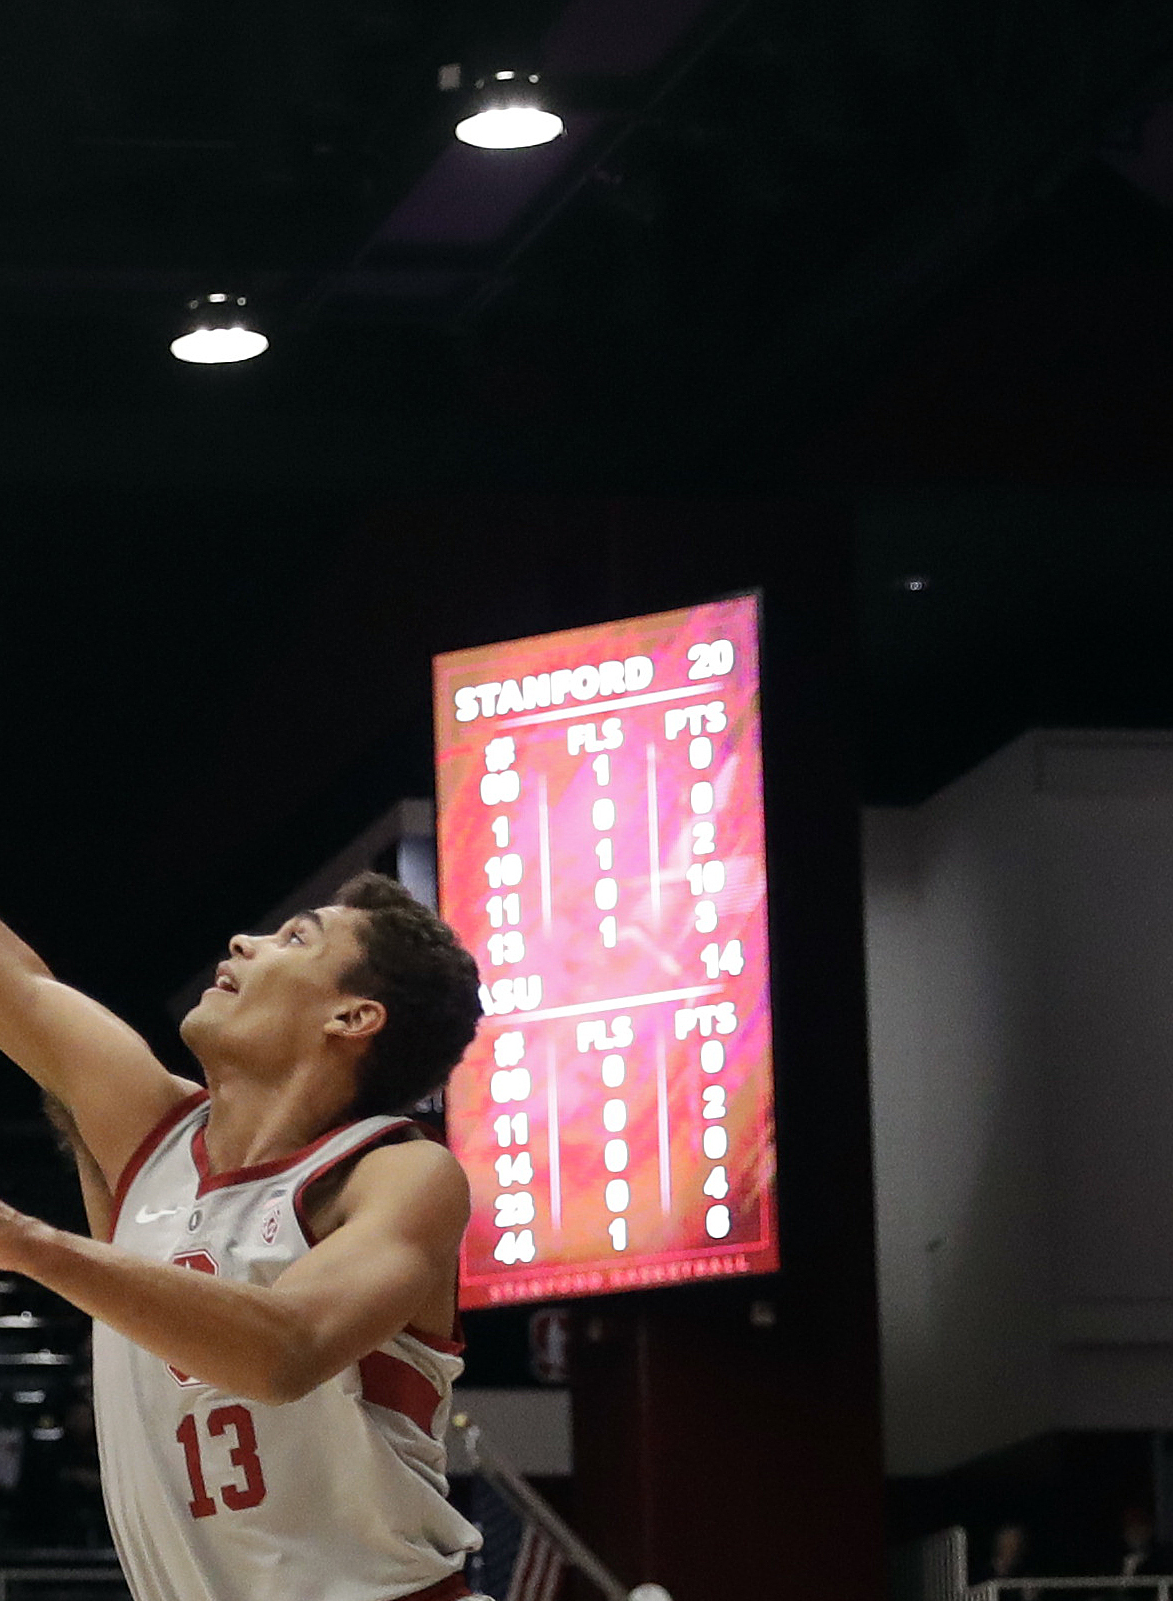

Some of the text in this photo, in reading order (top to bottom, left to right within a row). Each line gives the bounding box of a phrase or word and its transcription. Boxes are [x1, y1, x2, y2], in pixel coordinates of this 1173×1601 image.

[455, 639, 734, 722] STANFORD 20
[567, 717, 624, 756] FLS
[665, 701, 727, 740] PTS
[592, 753, 610, 786] 1
[492, 815, 509, 848] 1
[595, 838, 612, 871] 1
[692, 821, 715, 855] 2
[486, 892, 520, 928] 11
[599, 915, 617, 948] 1
[700, 939, 744, 979] 14
[576, 1015, 634, 1053] FLS
[674, 1001, 737, 1040] PTS
[493, 1112, 528, 1148] 11
[702, 1085, 726, 1119] 2
[495, 1151, 533, 1187] 14
[703, 1166, 729, 1199] 4
[494, 1229, 536, 1265] 44
[608, 1217, 626, 1251] 1
[176, 1404, 267, 1518] 13
